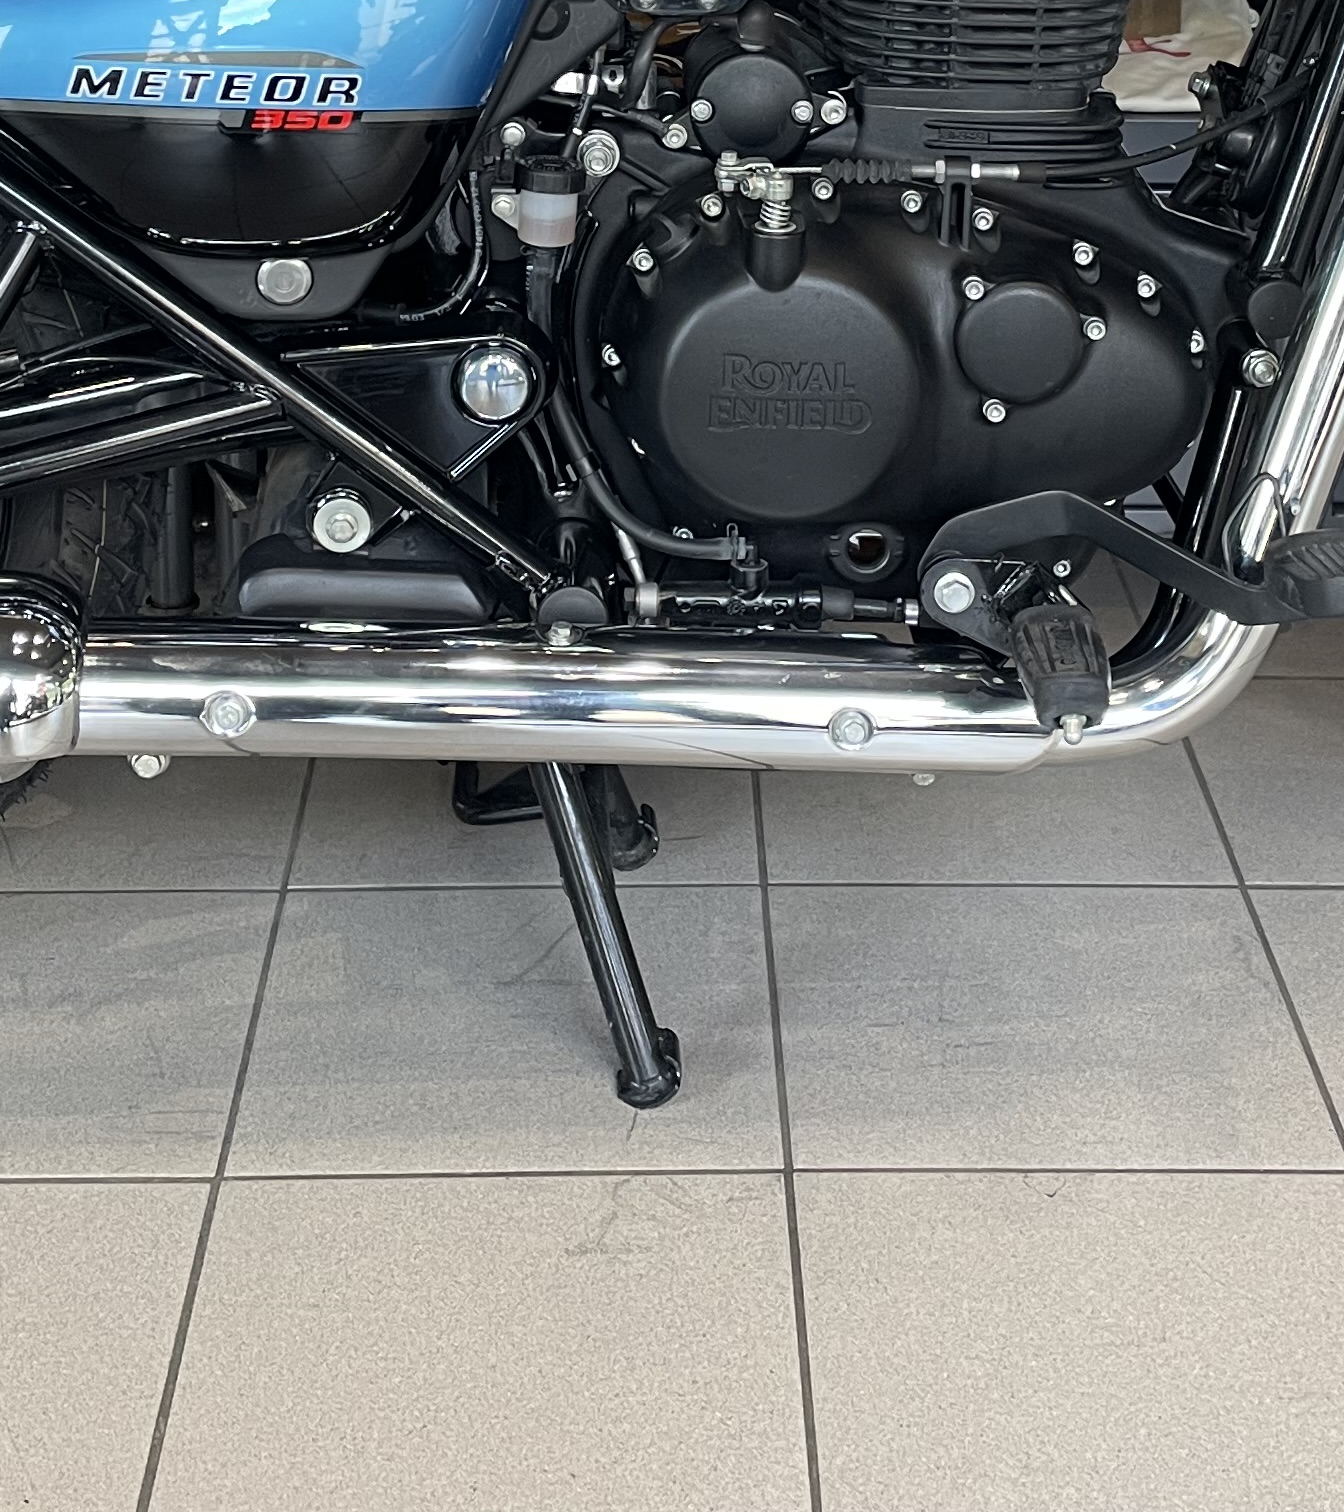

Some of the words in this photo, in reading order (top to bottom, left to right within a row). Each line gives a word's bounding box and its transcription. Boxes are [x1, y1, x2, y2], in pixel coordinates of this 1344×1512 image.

[66, 64, 362, 106] METEOR
[250, 109, 354, 131] 350
[722, 352, 856, 395] ROYAL
[706, 395, 873, 435] ENFIELD
